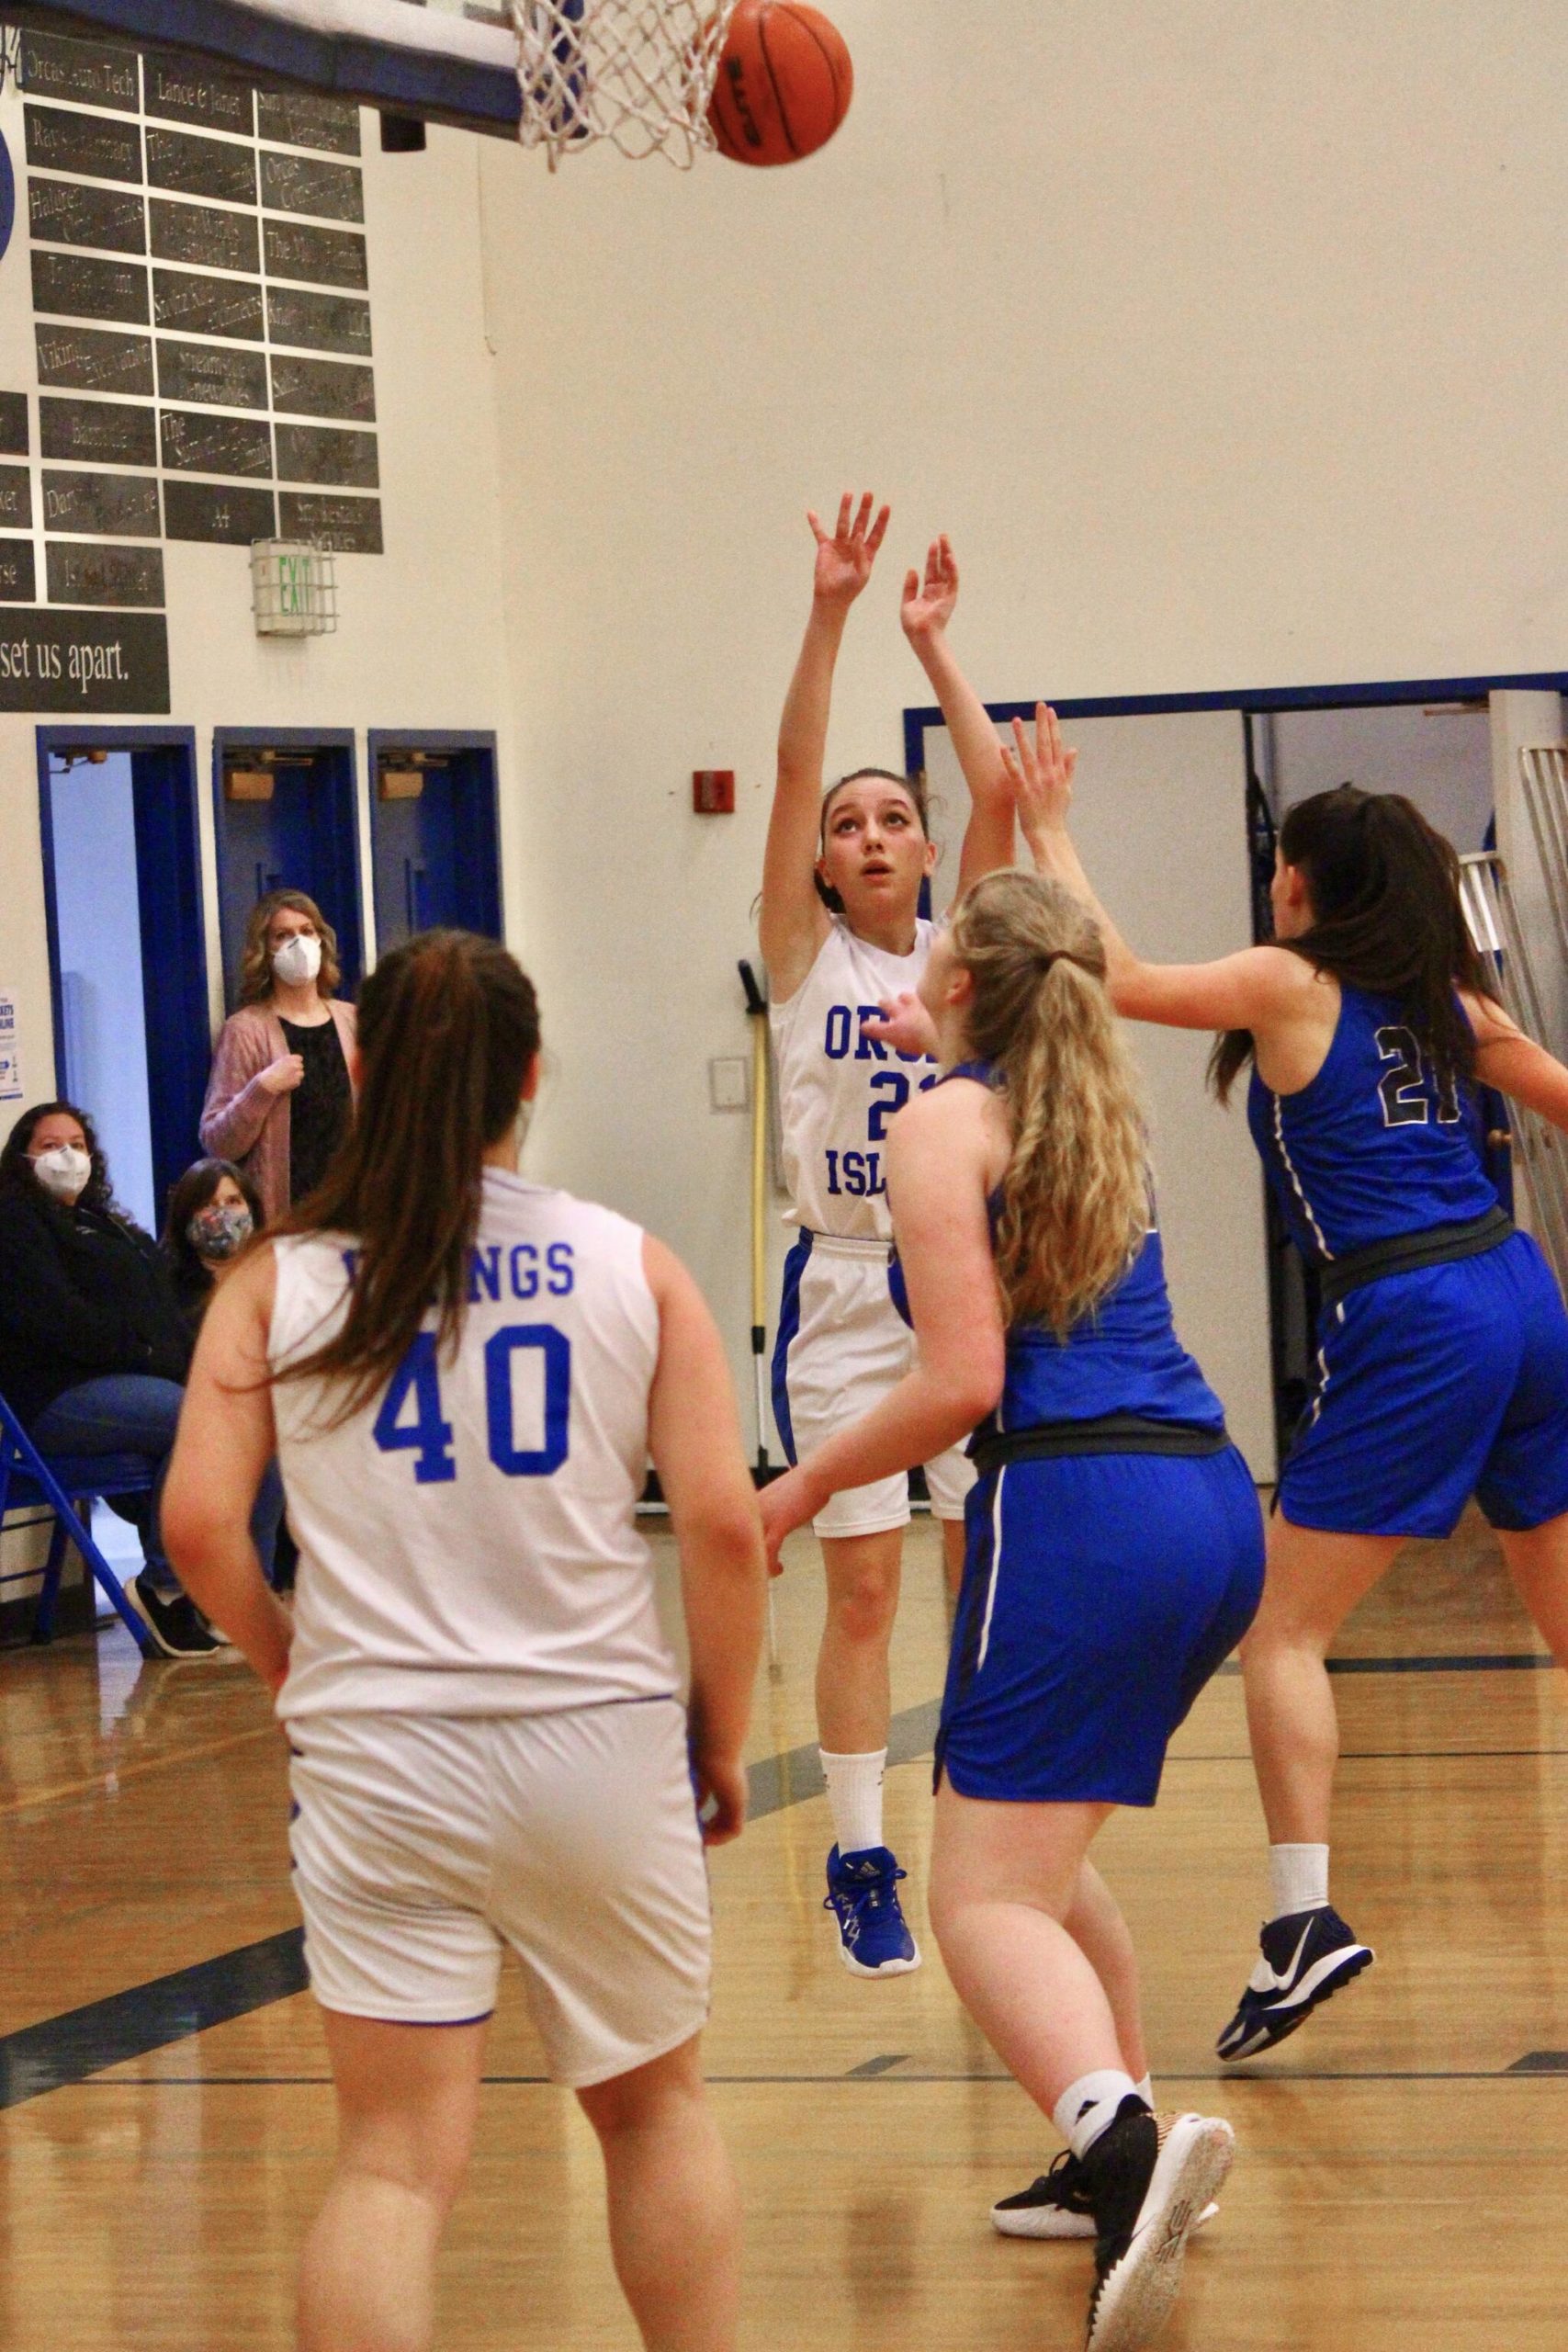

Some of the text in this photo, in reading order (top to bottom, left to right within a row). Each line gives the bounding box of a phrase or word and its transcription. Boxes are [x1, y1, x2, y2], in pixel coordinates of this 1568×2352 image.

[103, 64, 134, 96] Tech
[278, 555, 310, 616] EXIT
[0, 638, 130, 695] set us apart.
[371, 1323, 572, 1485] 40
